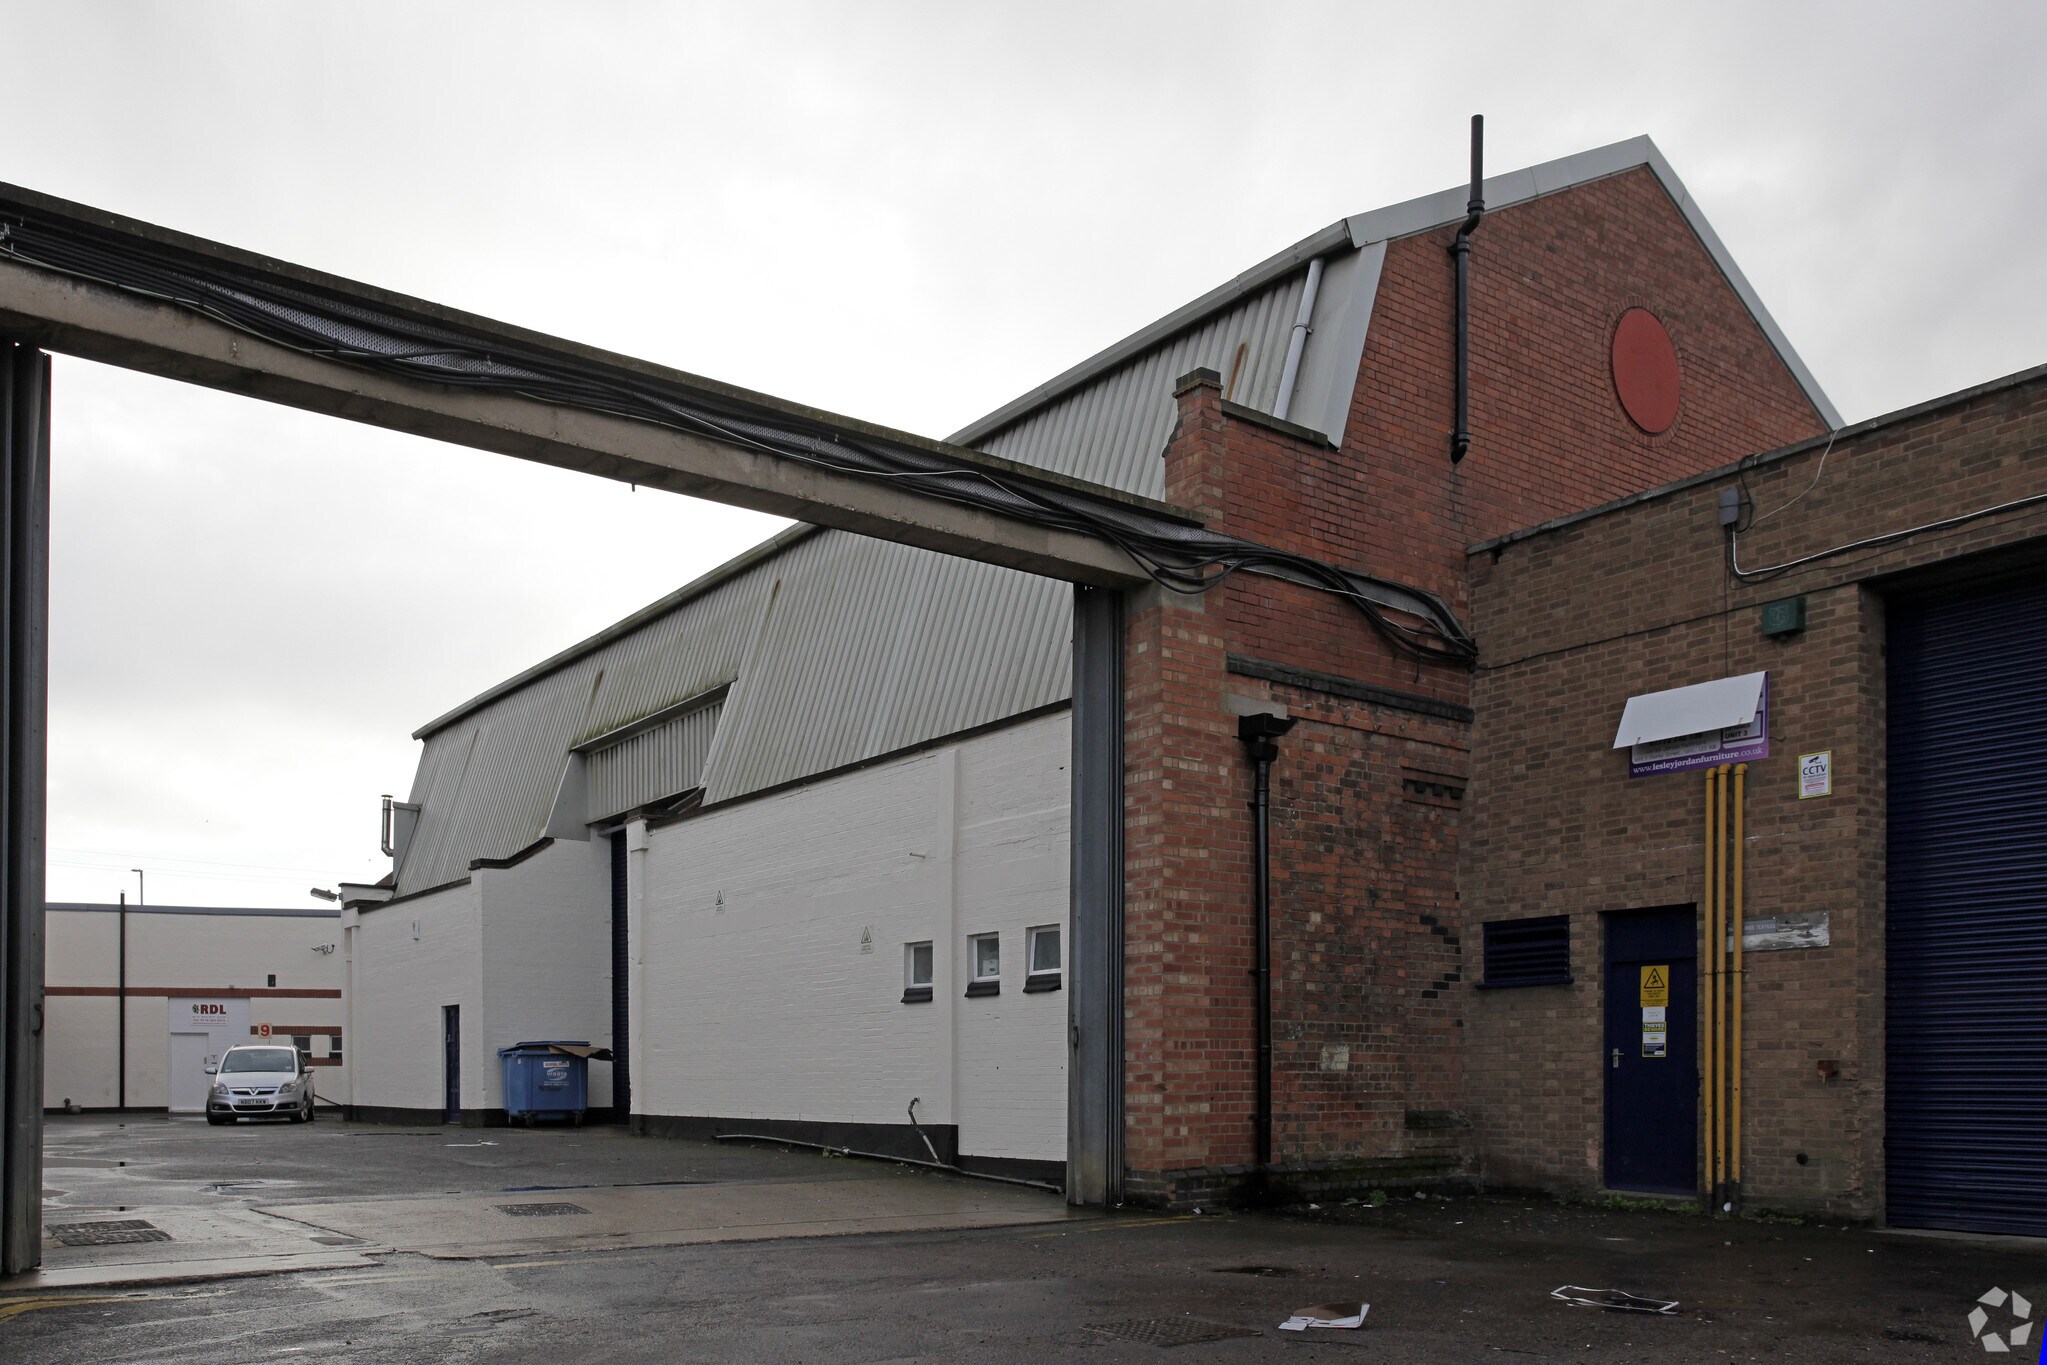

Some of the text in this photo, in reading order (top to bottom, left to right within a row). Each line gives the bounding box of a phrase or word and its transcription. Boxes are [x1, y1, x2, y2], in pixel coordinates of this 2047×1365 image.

[1725, 730, 1743, 739] UNIT
[1632, 747, 1763, 774] www.lesleyjordanfurniture.co.uk
[1802, 764, 1826, 775] CCTV
[200, 1004, 226, 1014] RDL
[260, 1024, 270, 1036] 9
